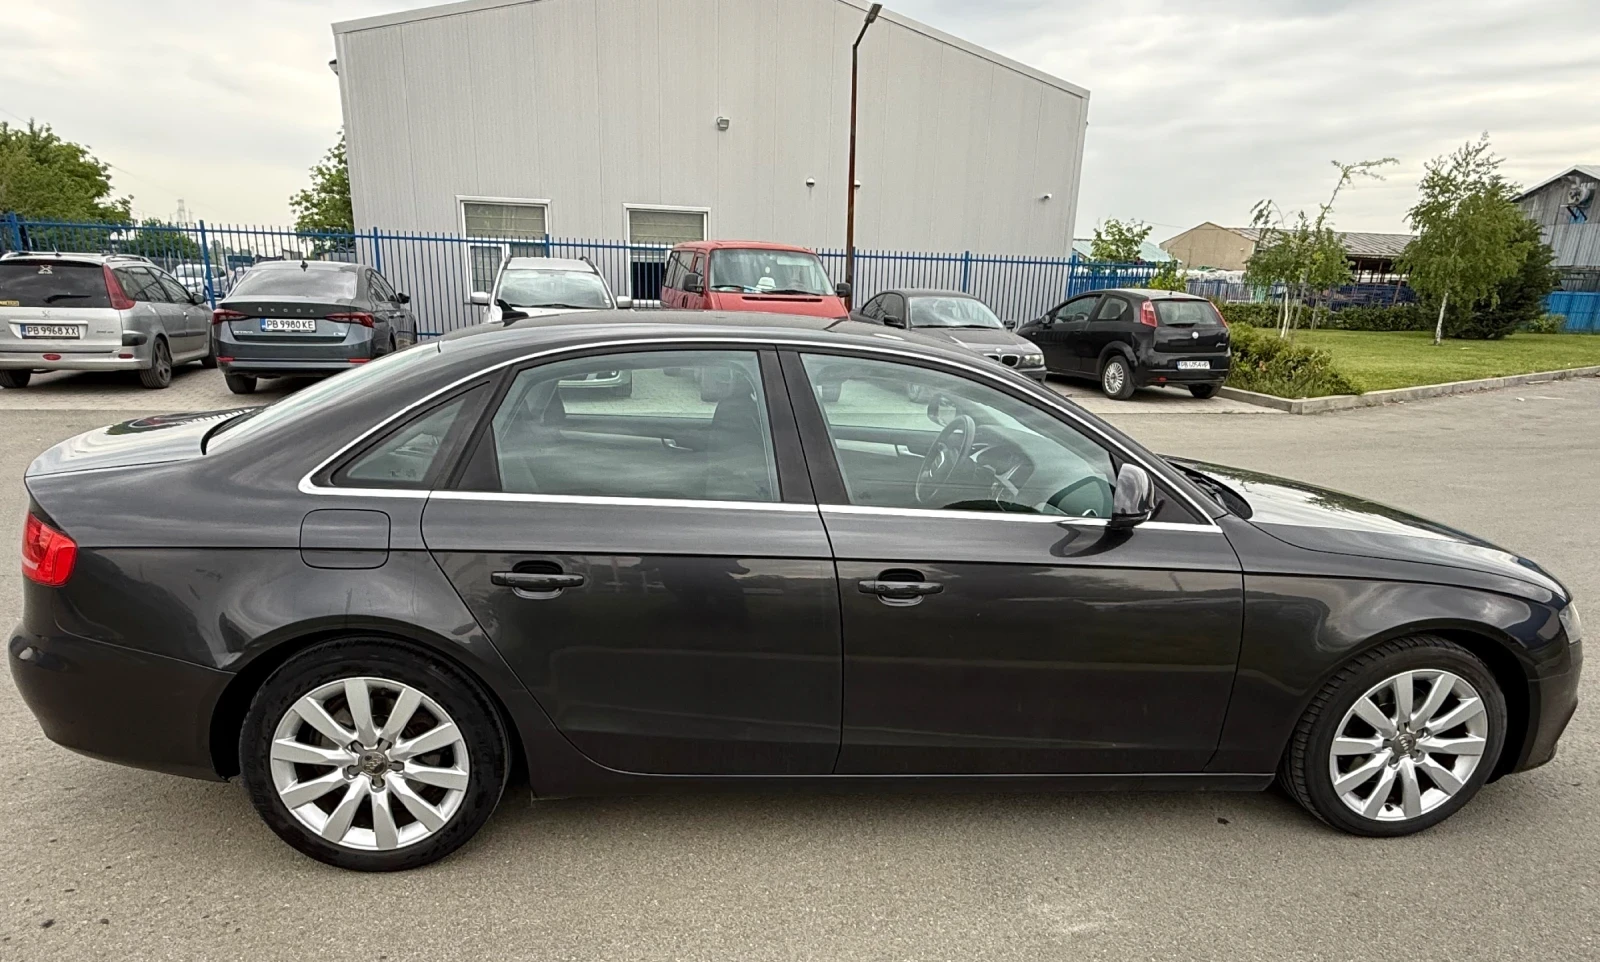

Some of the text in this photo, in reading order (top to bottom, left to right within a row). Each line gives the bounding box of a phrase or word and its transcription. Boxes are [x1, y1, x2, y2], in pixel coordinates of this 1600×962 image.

[266, 320, 314, 330] PB 9980 KE
[27, 326, 77, 336] PB 9968 XX
